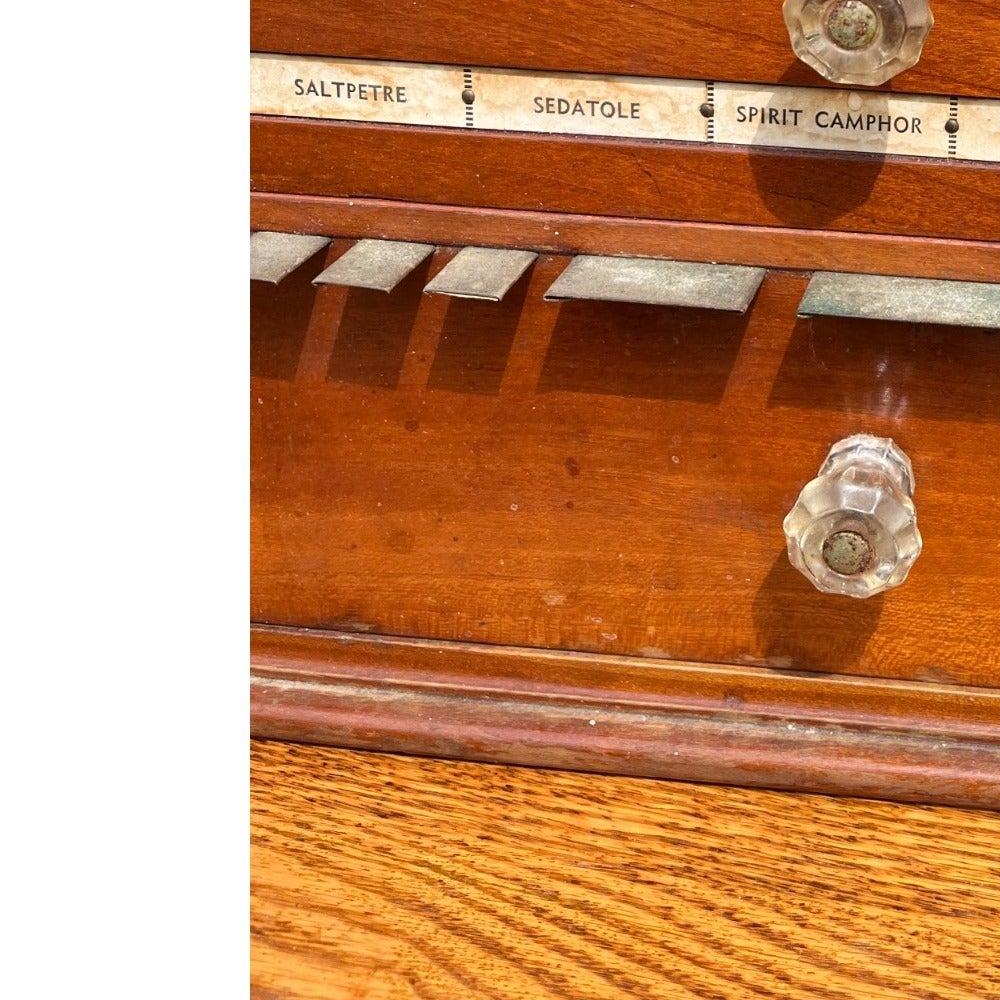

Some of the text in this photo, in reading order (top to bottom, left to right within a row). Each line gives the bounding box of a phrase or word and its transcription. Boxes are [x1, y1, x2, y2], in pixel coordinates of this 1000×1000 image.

[293, 78, 407, 103] SALTPETRE
[532, 96, 641, 120] SEDATOLE
[735, 105, 923, 134] SPIRIT CAMPHOR
